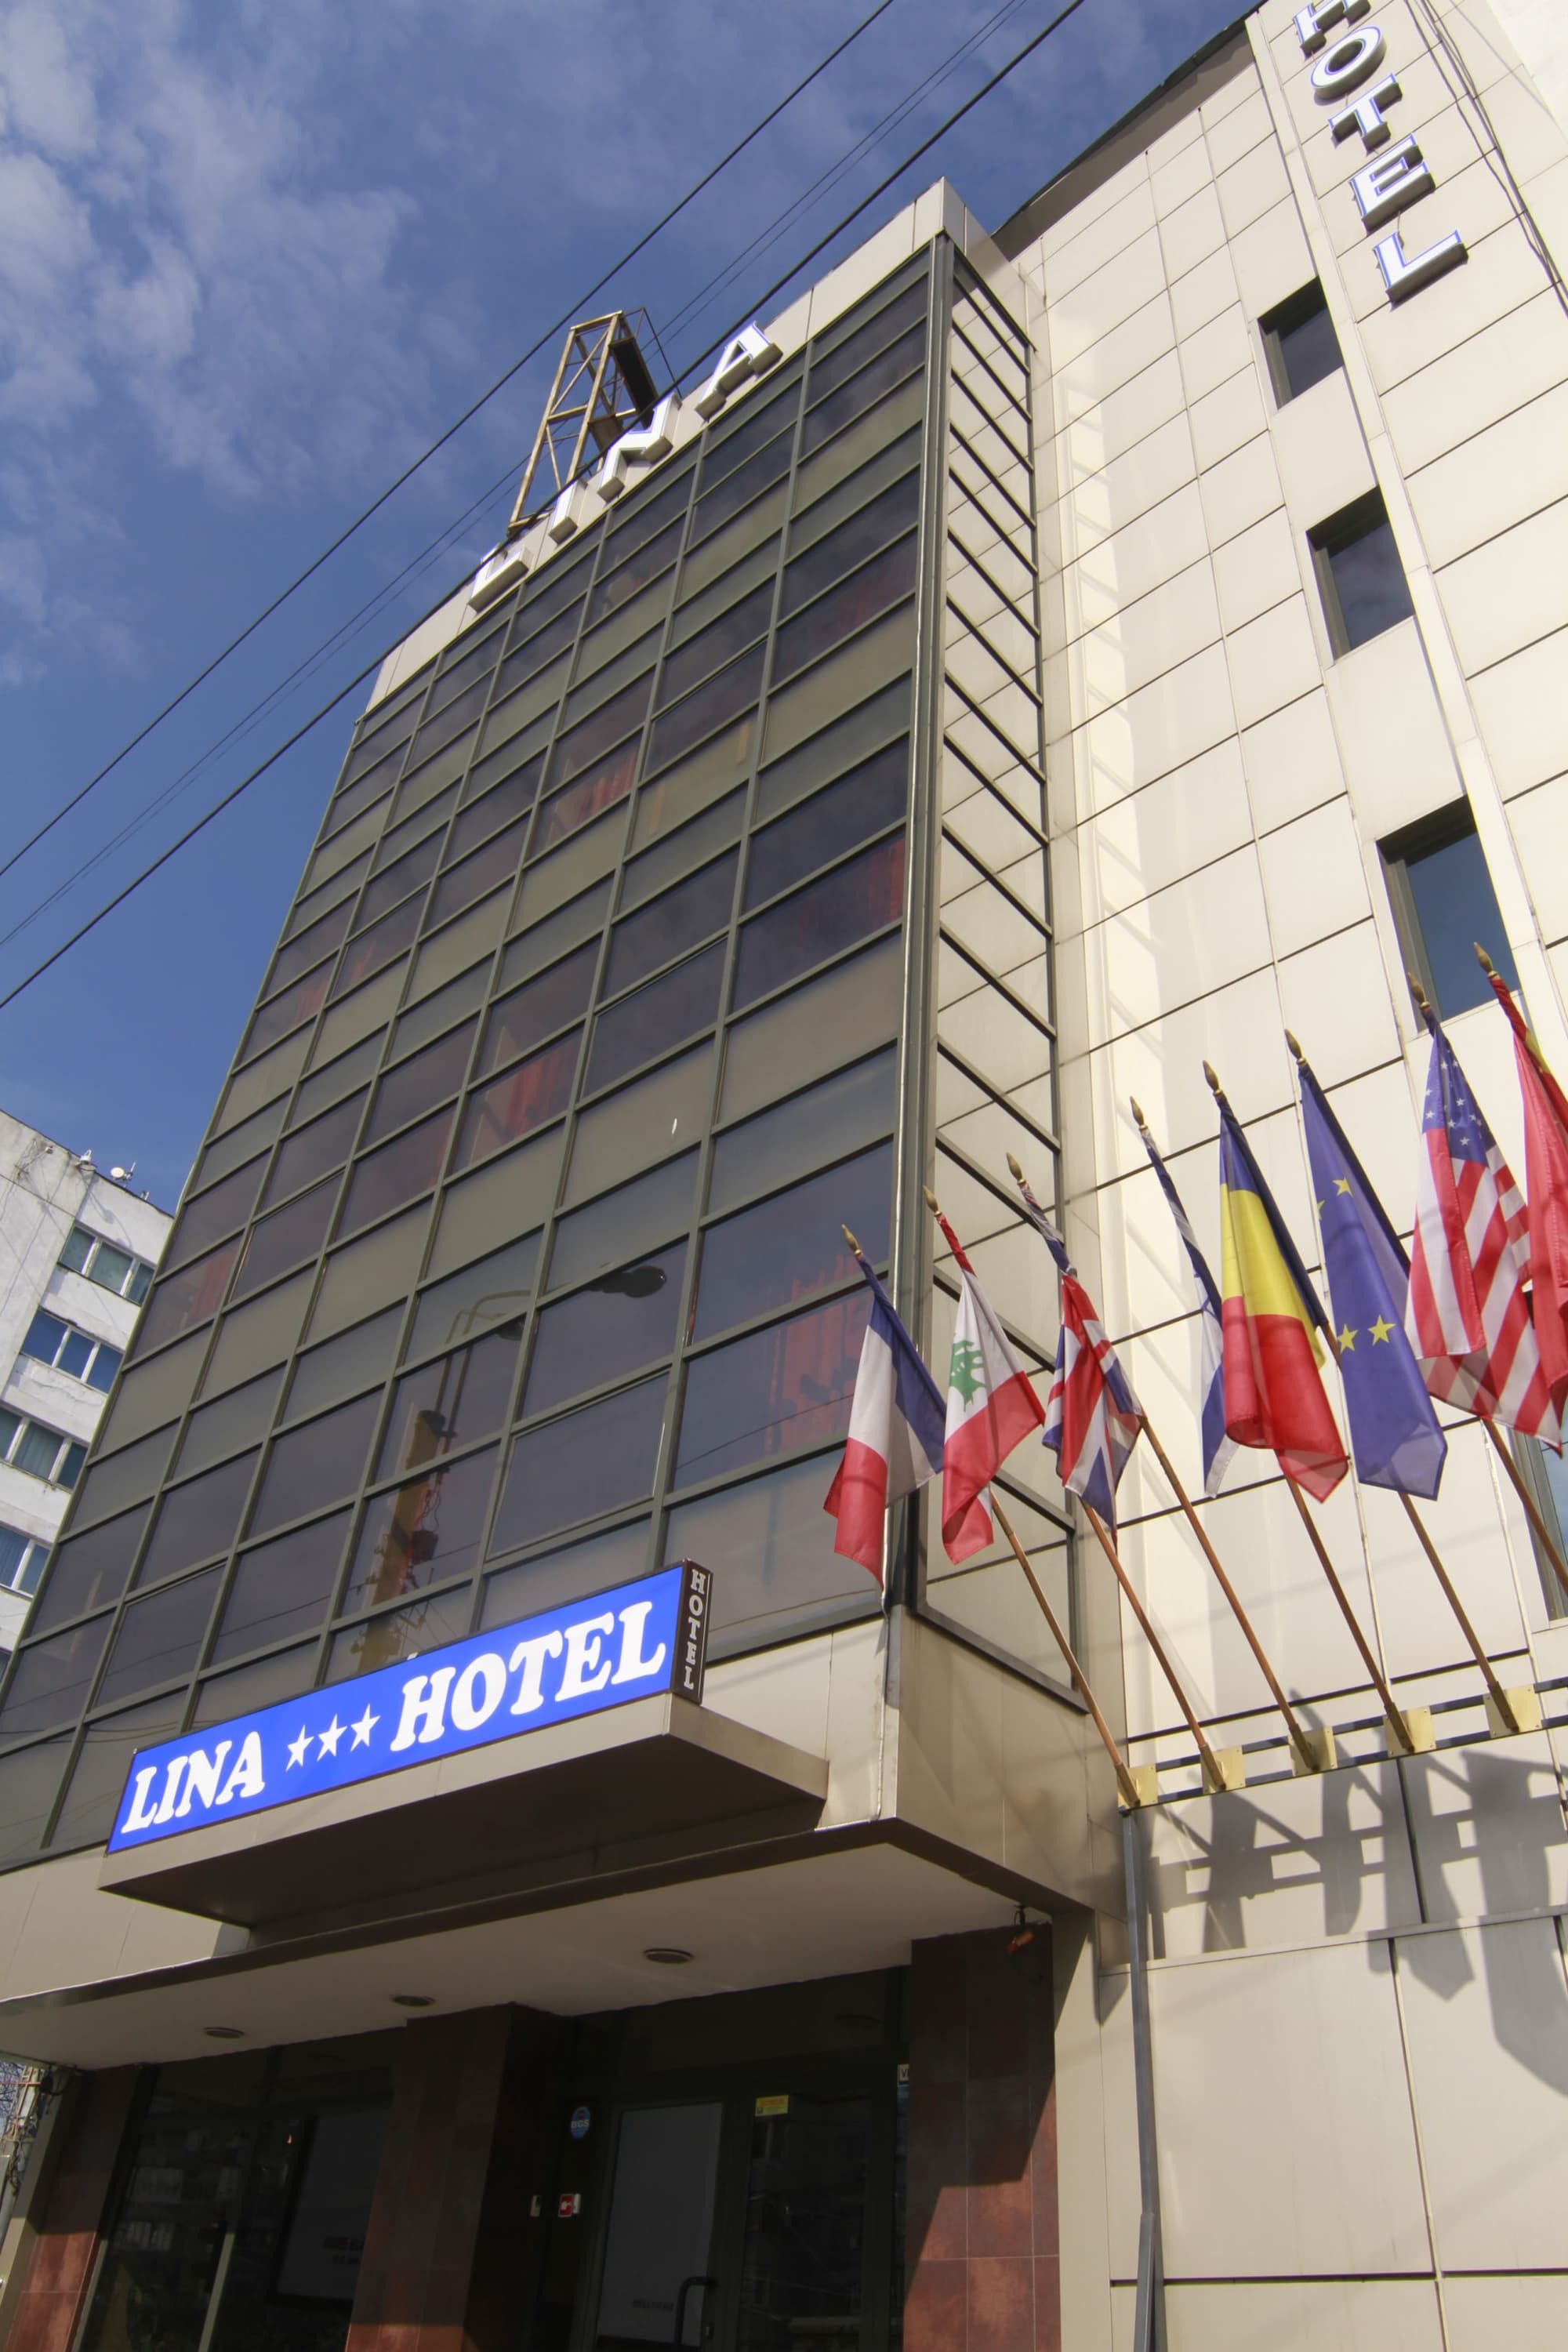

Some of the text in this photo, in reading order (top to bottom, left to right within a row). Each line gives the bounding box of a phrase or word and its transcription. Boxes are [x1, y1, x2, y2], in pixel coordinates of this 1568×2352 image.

[1294, 0, 1468, 304] HOTEL
[469, 321, 782, 612] LINA
[121, 1601, 666, 1834] LINA HOTEL
[684, 1569, 706, 1690] HOTEL
